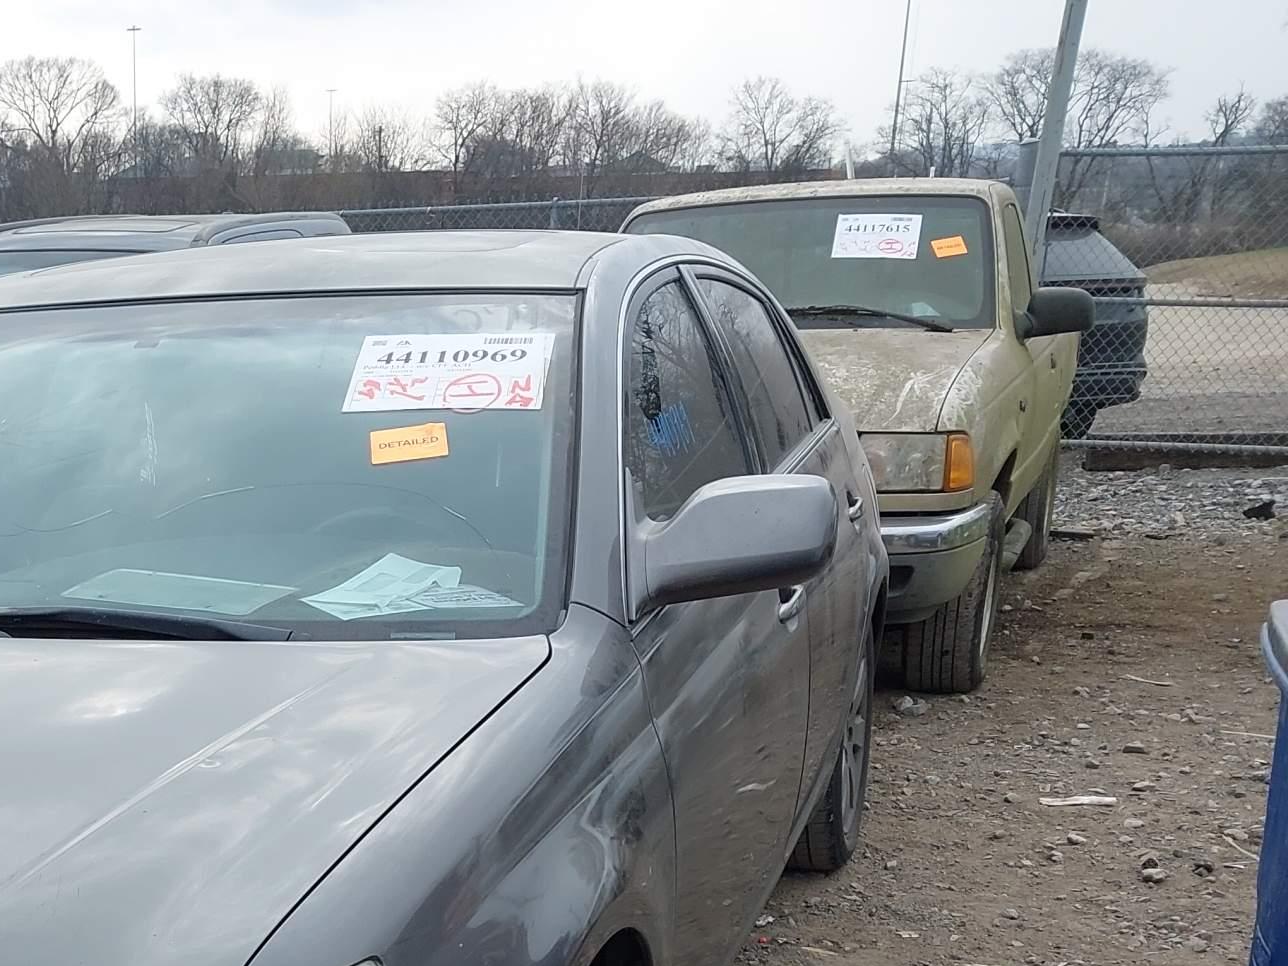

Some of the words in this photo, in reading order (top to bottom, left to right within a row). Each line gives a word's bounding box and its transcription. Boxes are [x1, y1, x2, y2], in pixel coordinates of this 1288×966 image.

[845, 224, 910, 232] 44117615
[377, 349, 528, 364] 44110969
[378, 436, 439, 450] DETAILED
